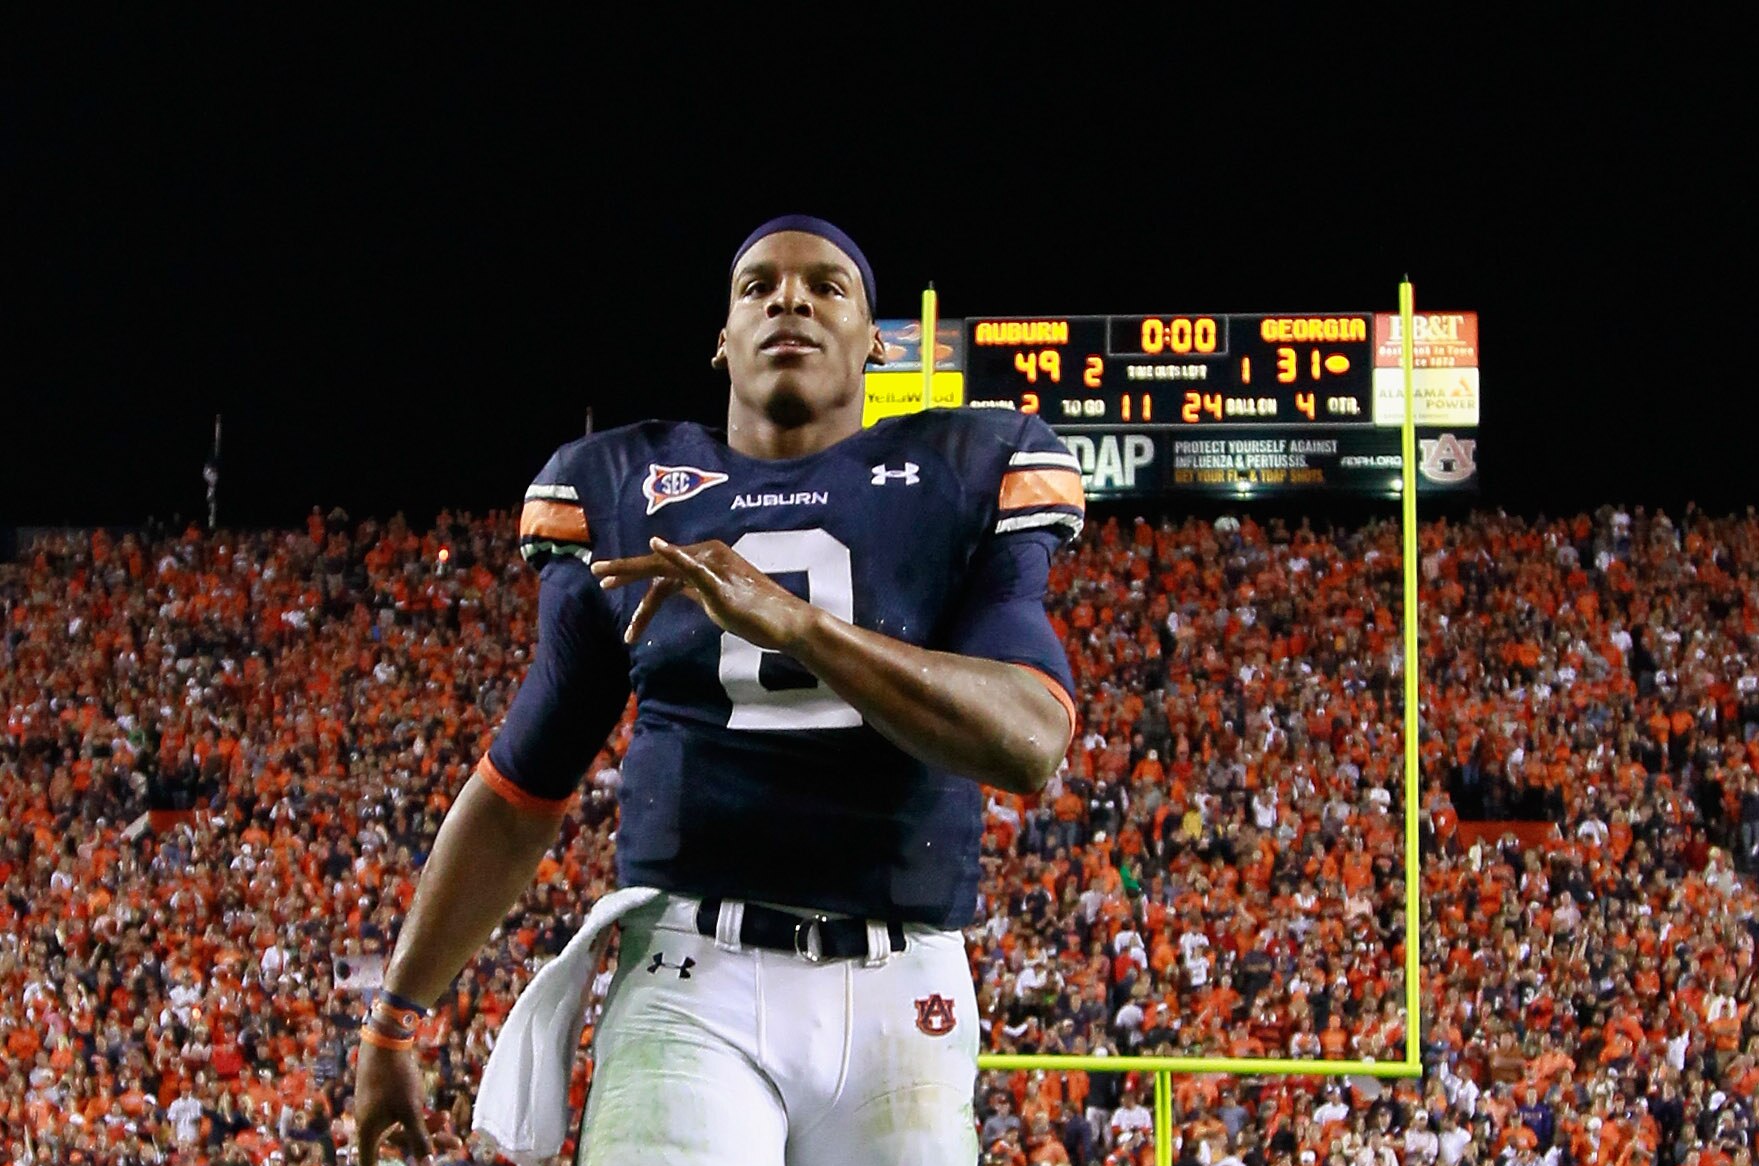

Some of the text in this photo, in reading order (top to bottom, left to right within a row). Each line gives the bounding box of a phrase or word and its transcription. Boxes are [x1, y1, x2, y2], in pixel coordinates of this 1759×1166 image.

[976, 322, 1068, 345] AUBURN
[1142, 318, 1216, 354] 0:00
[1261, 318, 1366, 342] GEORGIA
[1015, 349, 1061, 383] 49
[1083, 356, 1104, 388] 2
[1277, 347, 1321, 383] 31
[1379, 388, 1446, 398] ALAAMA
[1425, 399, 1475, 409] POWER
[1062, 399, 1105, 416] TO GO
[1182, 391, 1222, 422] 24
[1225, 398, 1256, 416] BALL
[1296, 392, 1316, 420] 4
[1175, 440, 1338, 454] PROTECT YOURSELF AGAINST
[1175, 454, 1234, 468] INFLUENZA
[1235, 454, 1245, 468] &
[661, 471, 691, 495] SEC
[730, 491, 829, 510] AUBURN
